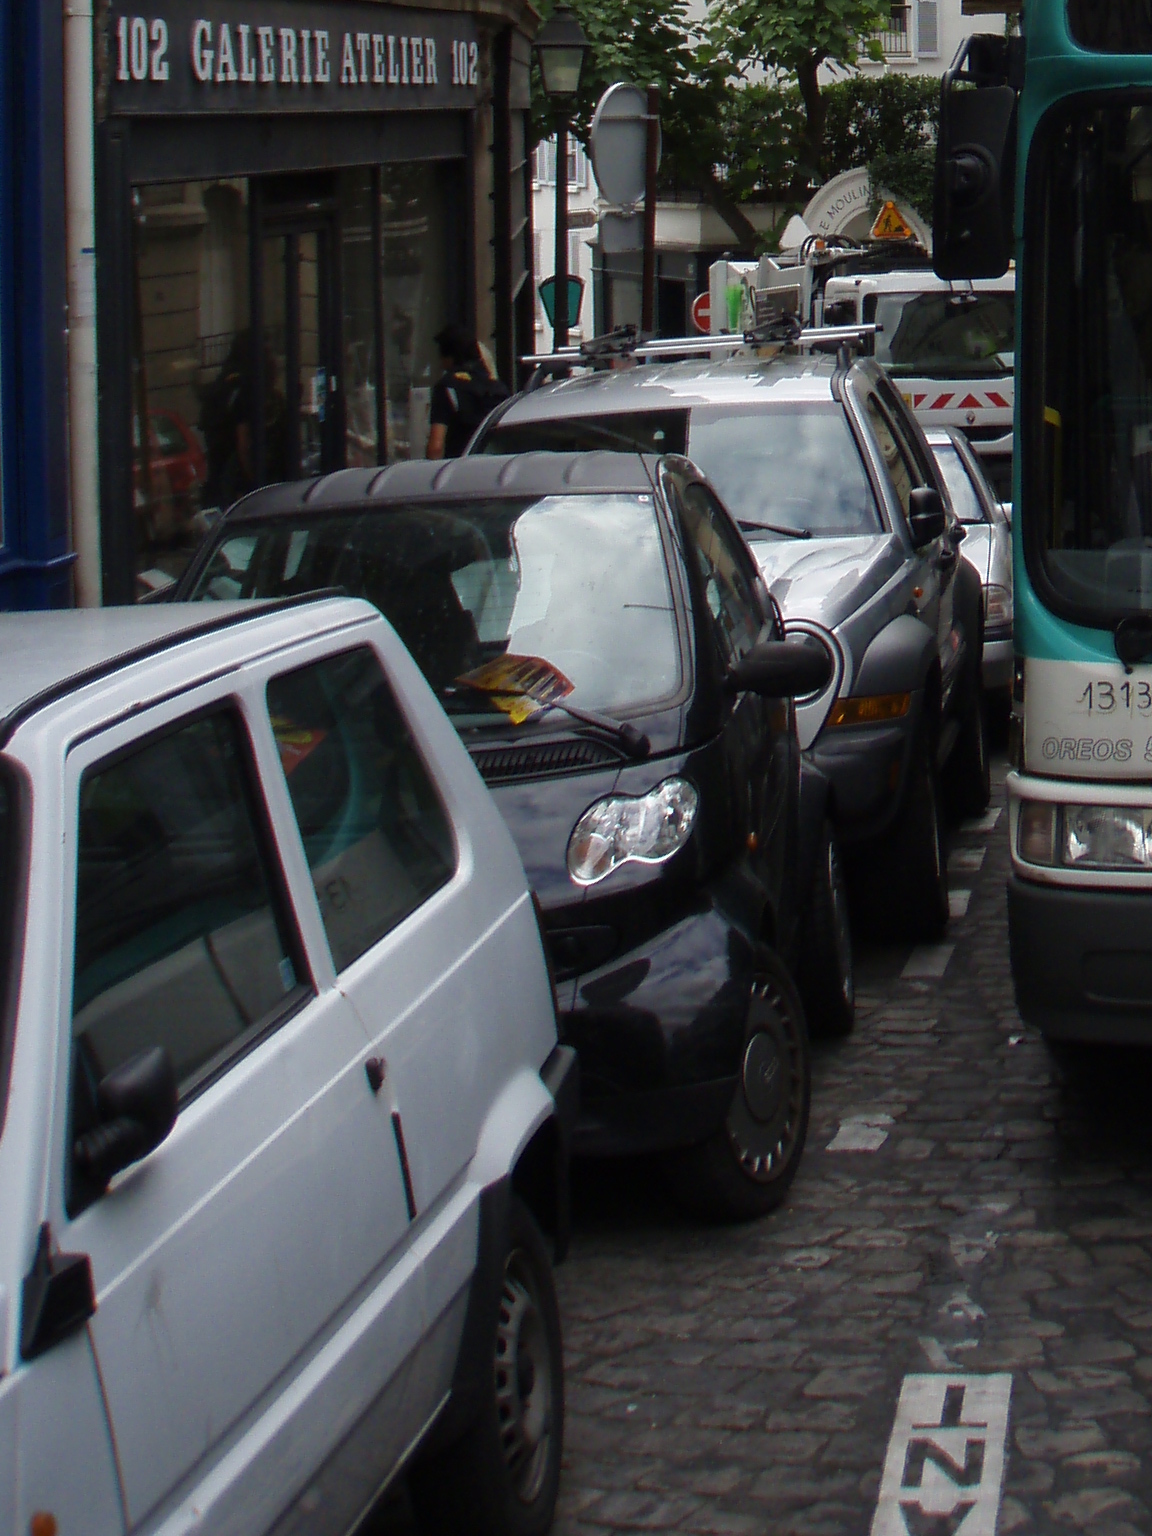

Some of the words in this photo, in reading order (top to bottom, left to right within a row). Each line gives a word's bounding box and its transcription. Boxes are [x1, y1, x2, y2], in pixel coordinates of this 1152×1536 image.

[116, 16, 170, 81] 102
[191, 19, 331, 84] GALERIE
[339, 32, 439, 85] ATELIER
[450, 40, 479, 86] 102
[1081, 680, 1152, 710] 1313
[1041, 736, 1133, 762] OREOS
